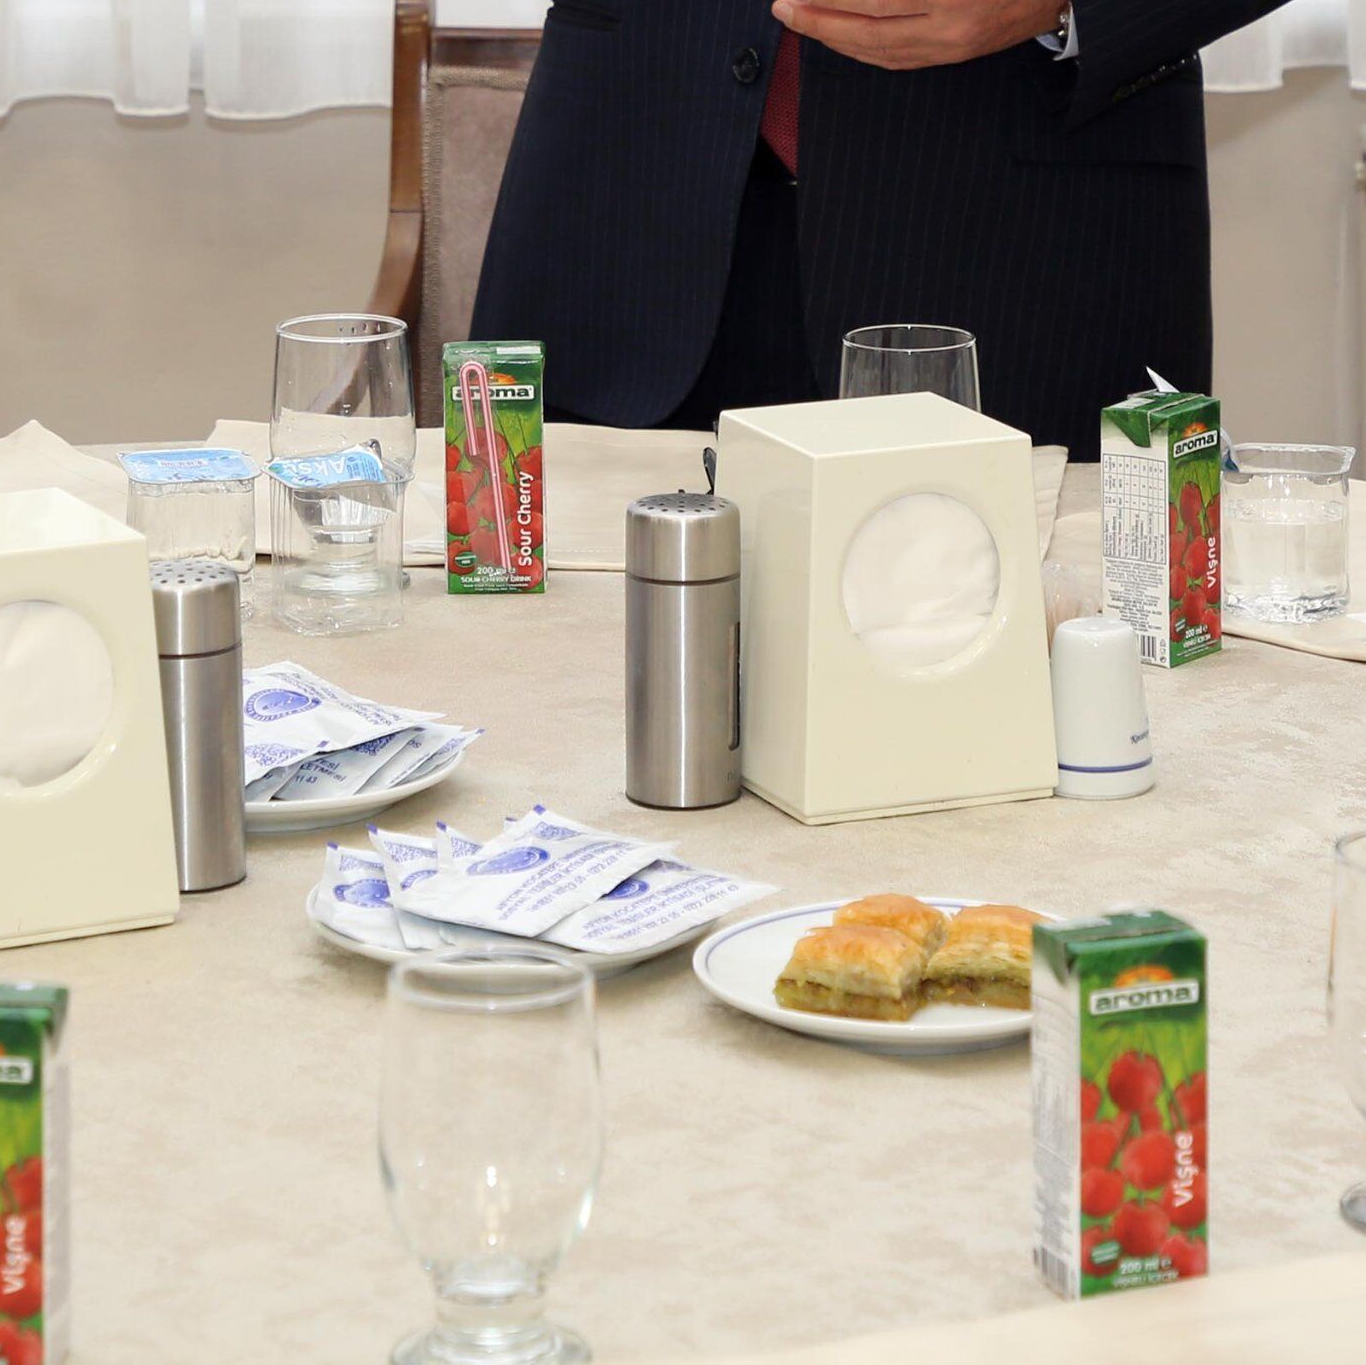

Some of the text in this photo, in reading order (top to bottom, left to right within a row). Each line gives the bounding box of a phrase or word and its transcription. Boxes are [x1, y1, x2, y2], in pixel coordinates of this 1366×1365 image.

[1175, 433, 1215, 455] aroma
[517, 471, 534, 566] Sour Cherry
[1206, 537, 1219, 589] Vişne
[1096, 987, 1190, 1010] aroma
[1173, 1133, 1198, 1208] Vişne
[2, 1216, 31, 1295] Vişne
